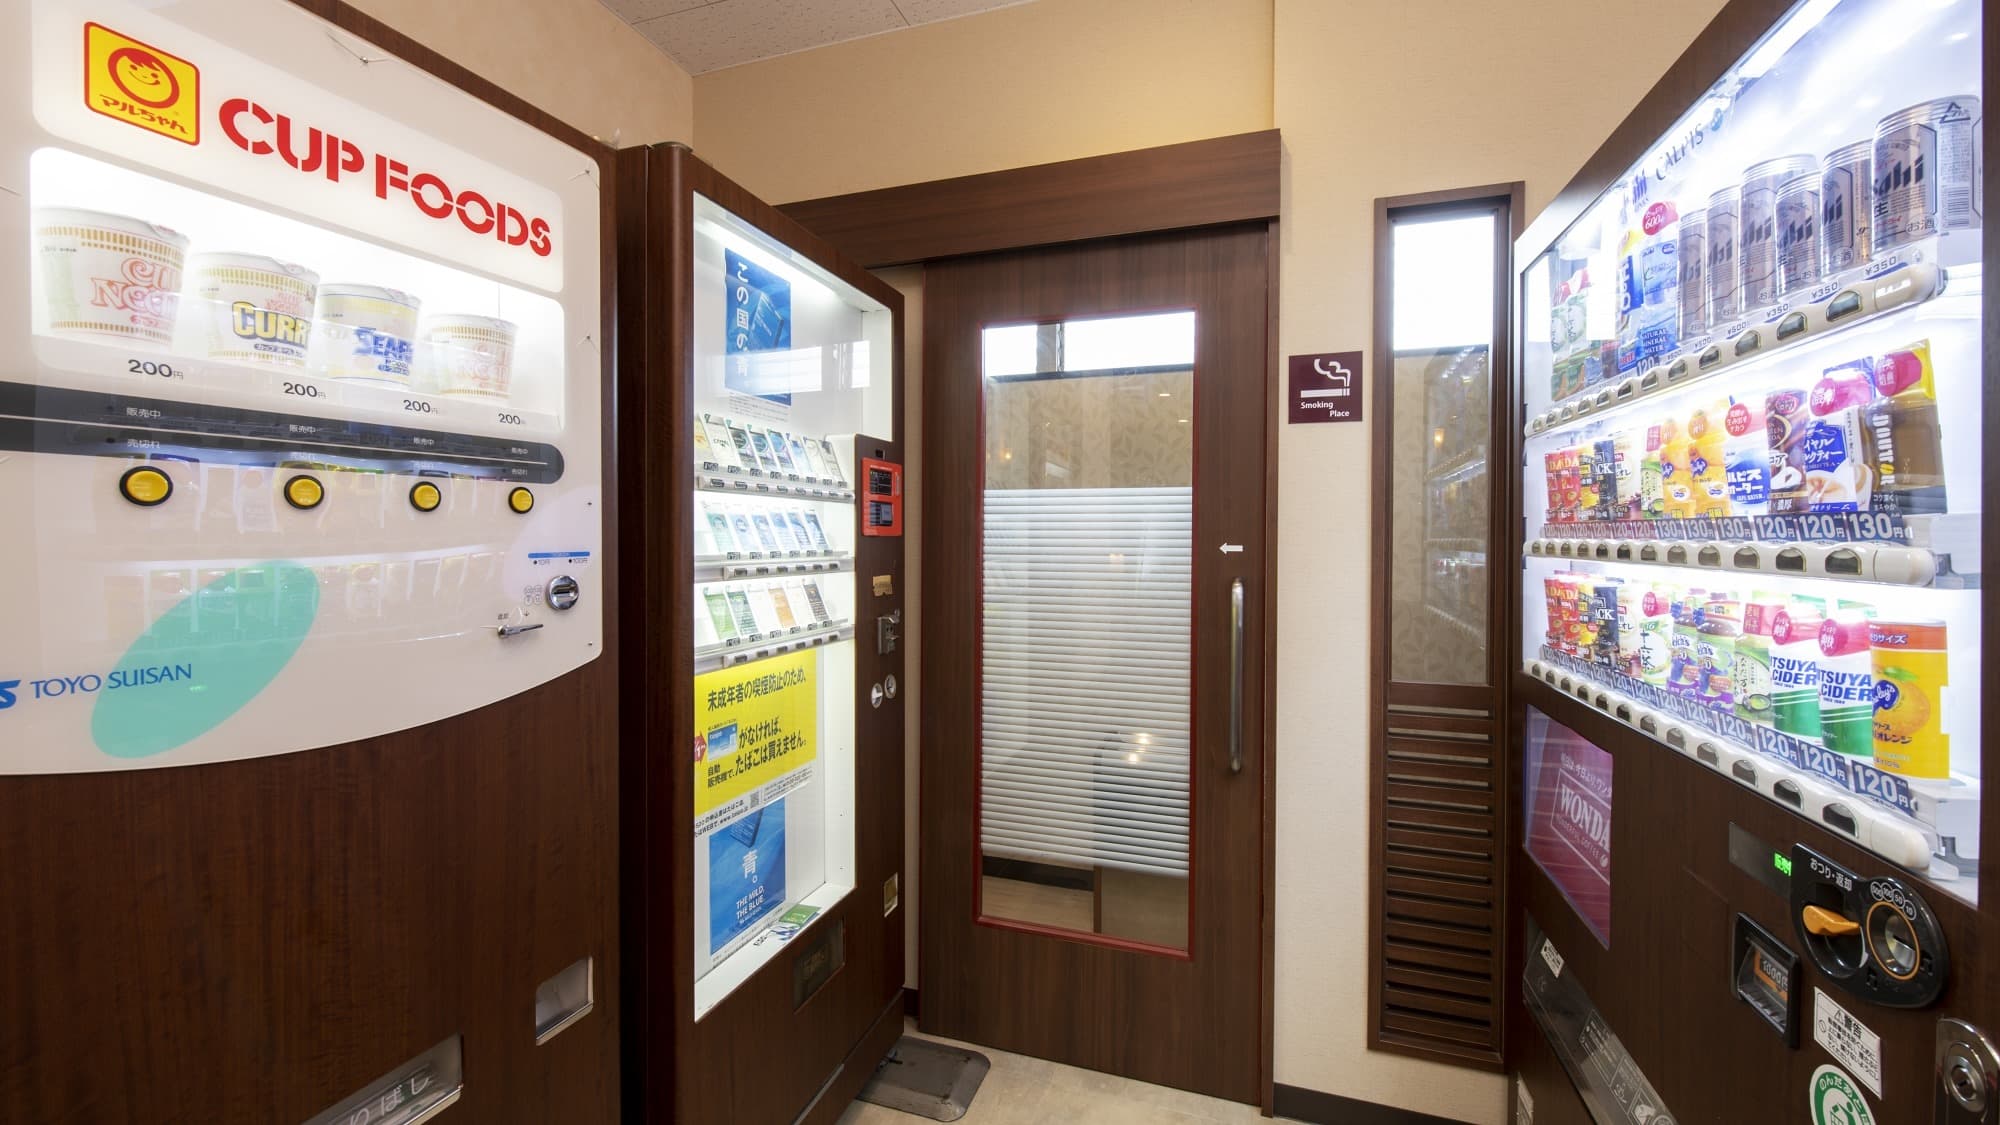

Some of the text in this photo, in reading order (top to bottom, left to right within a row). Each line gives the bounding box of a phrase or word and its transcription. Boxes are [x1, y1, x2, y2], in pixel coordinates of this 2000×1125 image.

[99, 94, 188, 134] マルちゃん
[219, 98, 551, 257] CUP FOODS
[1875, 200, 1889, 218] 生
[1907, 220, 1935, 233] お酒
[1865, 256, 1897, 275] ¥350
[1811, 282, 1838, 299] ¥350
[1766, 303, 1789, 318] ¥350
[128, 359, 184, 381] 200円
[283, 382, 326, 399] 200円
[126, 407, 161, 419] 販売中
[1300, 401, 1334, 410] Smoking
[127, 438, 160, 449] 売切れ
[1717, 519, 1753, 539] 130円
[1756, 517, 1795, 539] 120円
[1800, 513, 1845, 539] 120円
[1850, 512, 1903, 539] 130円
[30, 663, 192, 699] TOYO SUISAN
[707, 667, 807, 712] 未成年者の喫煙防止のため、
[1772, 669, 1817, 686] CIDER
[1821, 684, 1874, 701] CIDER
[1685, 699, 1714, 727] 120円
[739, 717, 782, 750] がなければ、
[1720, 713, 1754, 742] 120円
[735, 731, 807, 776] たばこは買えません。
[1758, 726, 1797, 761] 120円
[708, 764, 721, 777] 自動
[1800, 742, 1846, 782] 120円
[1854, 763, 1910, 808] 120円
[1561, 783, 1611, 853] WONDA
[742, 849, 758, 884] 青。
[1810, 857, 1852, 892] おつり・返却
[736, 896, 748, 909] THE
[736, 907, 748, 920] THE
[1845, 1014, 1862, 1040] 警告
